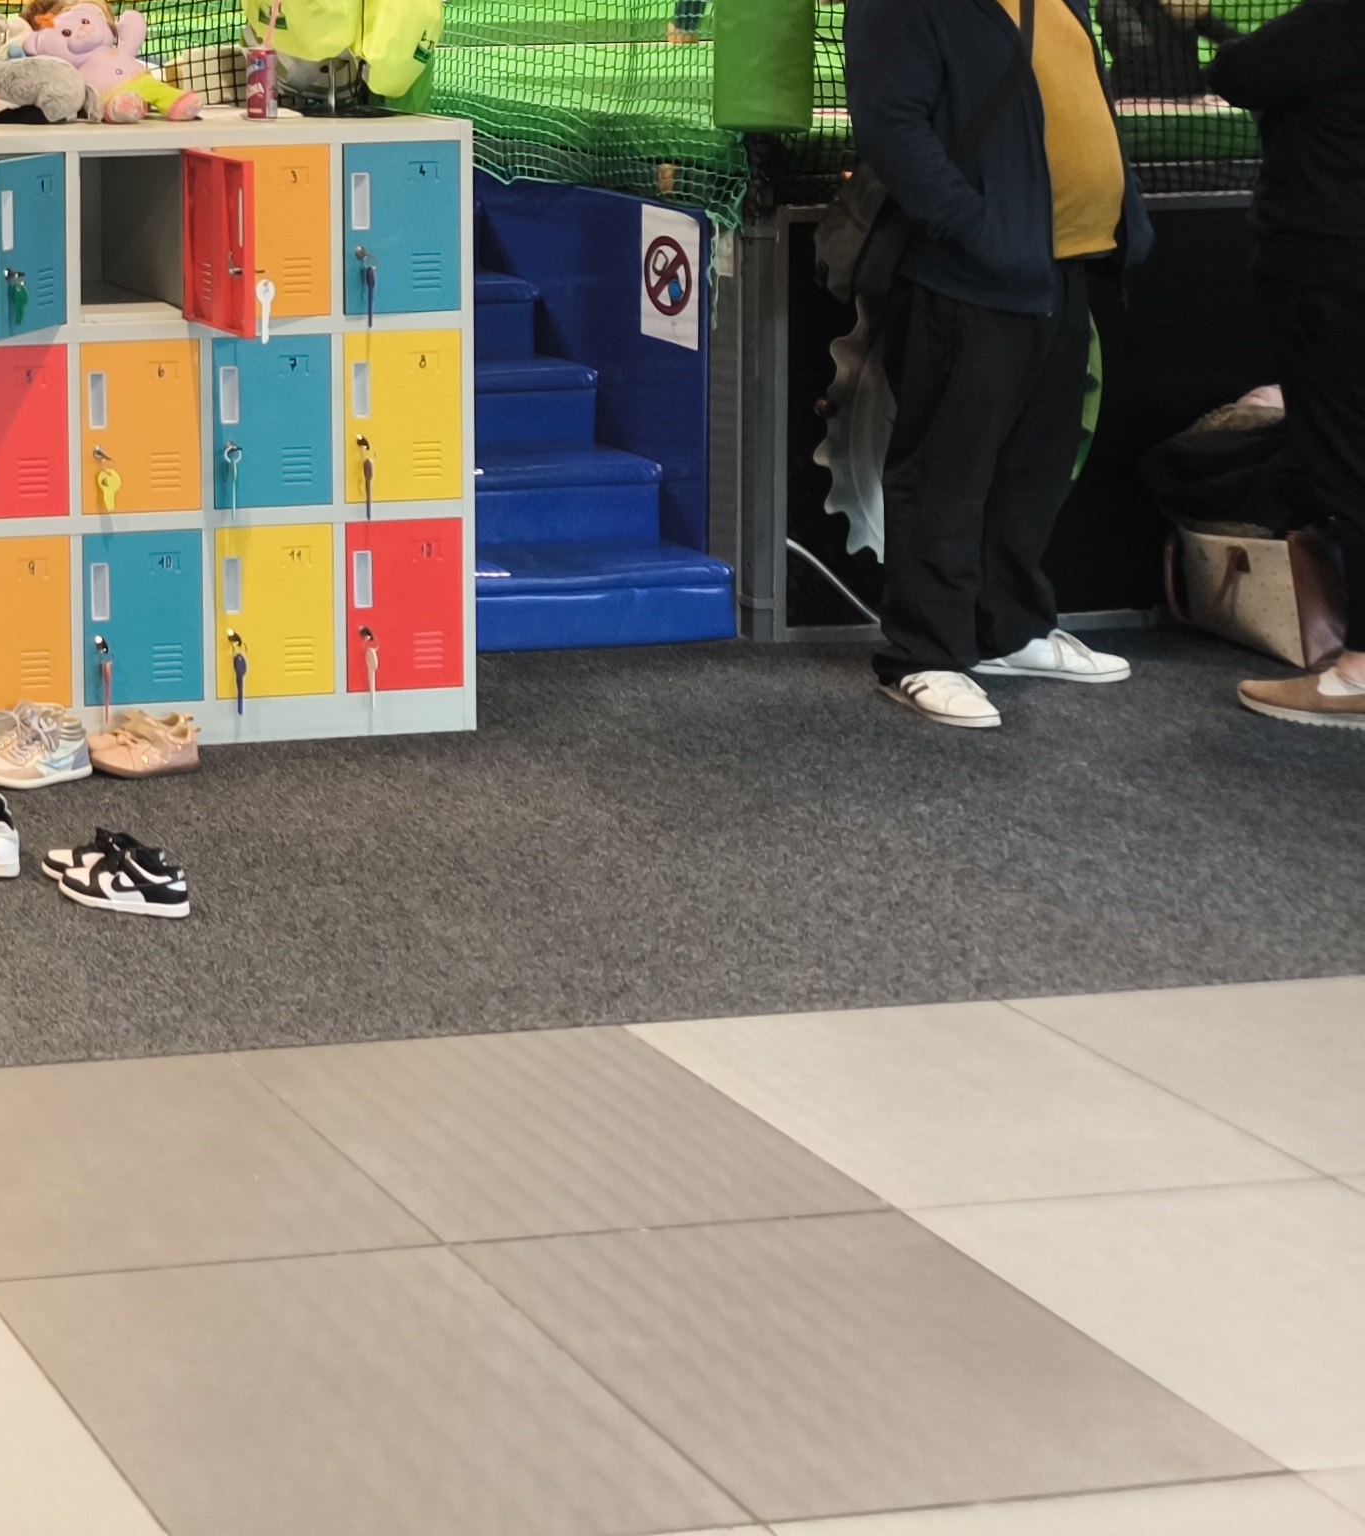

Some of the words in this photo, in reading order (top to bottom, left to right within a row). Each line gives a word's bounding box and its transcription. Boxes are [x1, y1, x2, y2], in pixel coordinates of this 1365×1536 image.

[290, 170, 298, 184] 3
[289, 357, 298, 372] 7
[419, 355, 427, 369] 8
[157, 364, 166, 378] 6
[158, 555, 173, 570] 10
